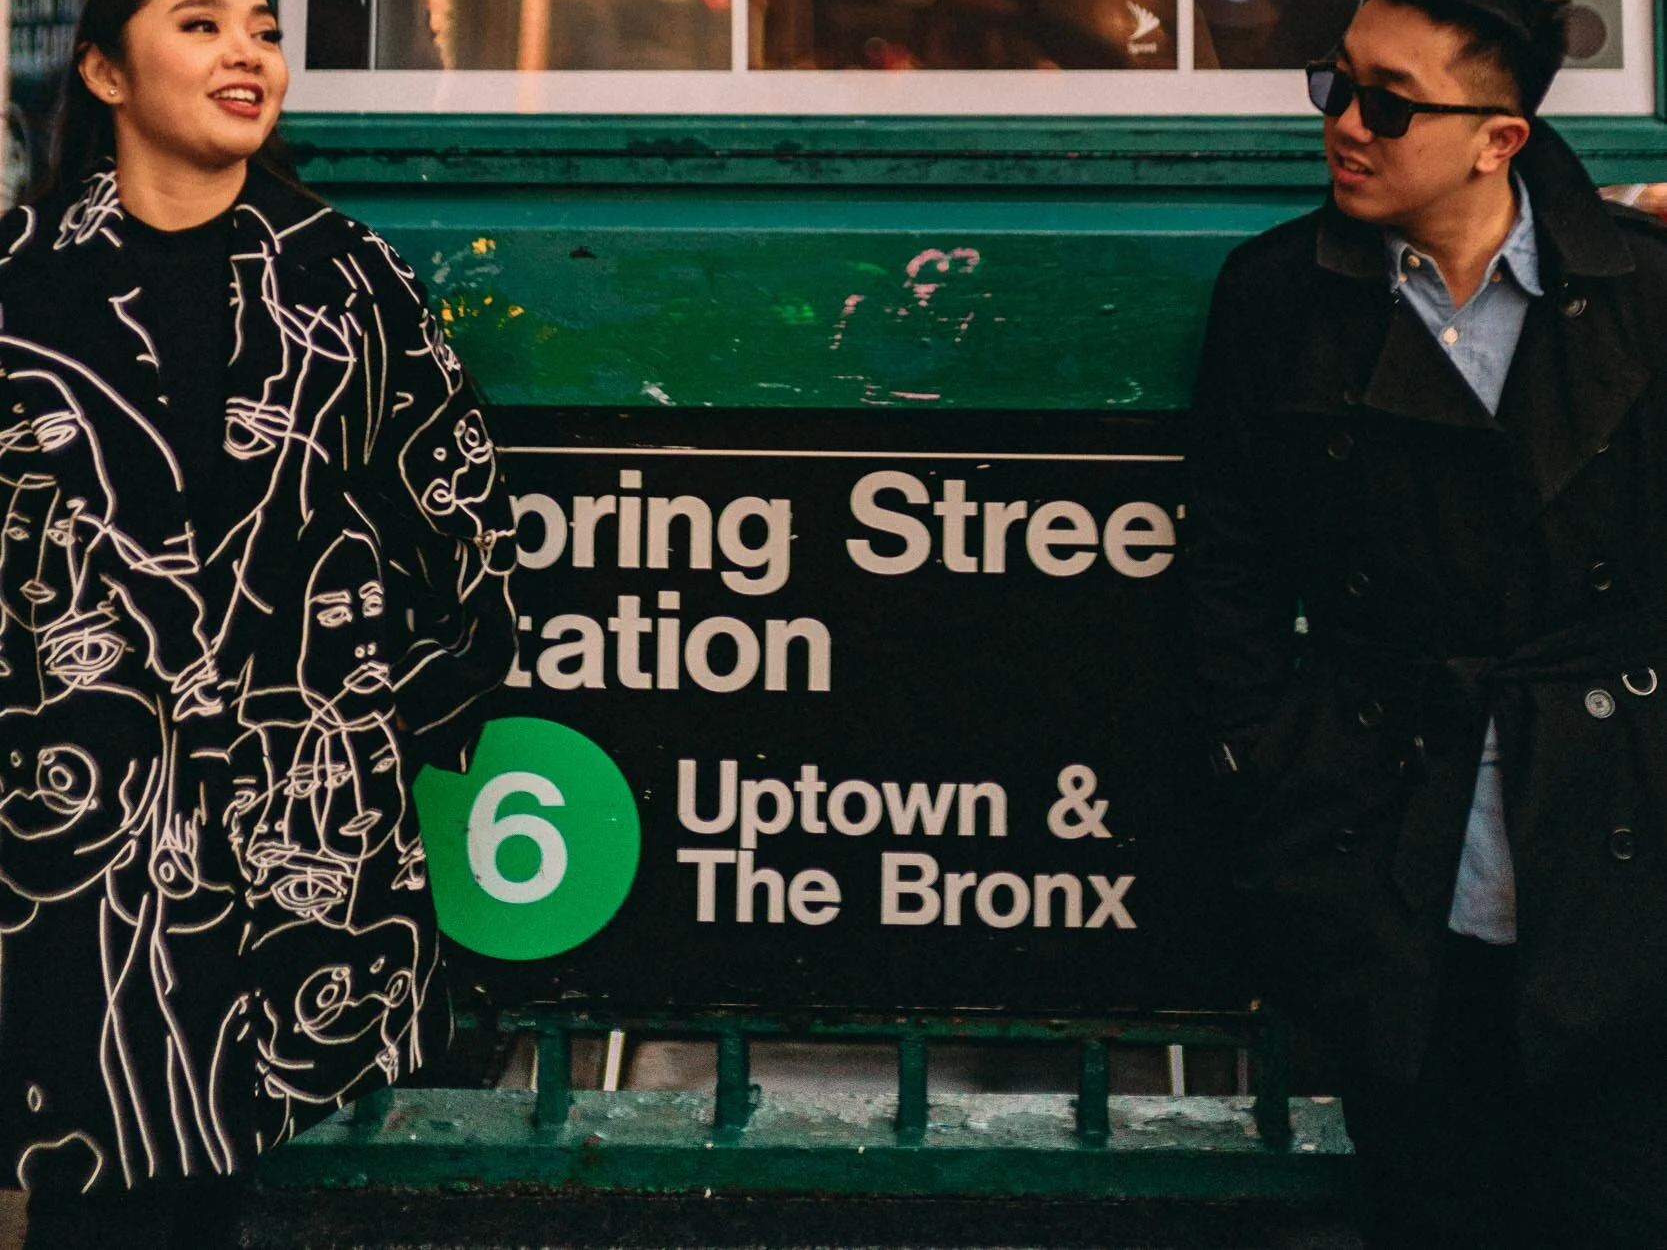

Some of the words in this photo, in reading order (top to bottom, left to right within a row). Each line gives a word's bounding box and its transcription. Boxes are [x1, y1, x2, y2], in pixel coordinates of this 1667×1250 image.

[508, 469, 799, 596] pring
[845, 470, 1185, 578] Stree
[504, 590, 832, 693] ation
[467, 771, 568, 904] 6
[677, 759, 1008, 849] Uptown
[1047, 764, 1113, 840] &
[676, 849, 842, 926] The
[880, 851, 1138, 930] Bronx
